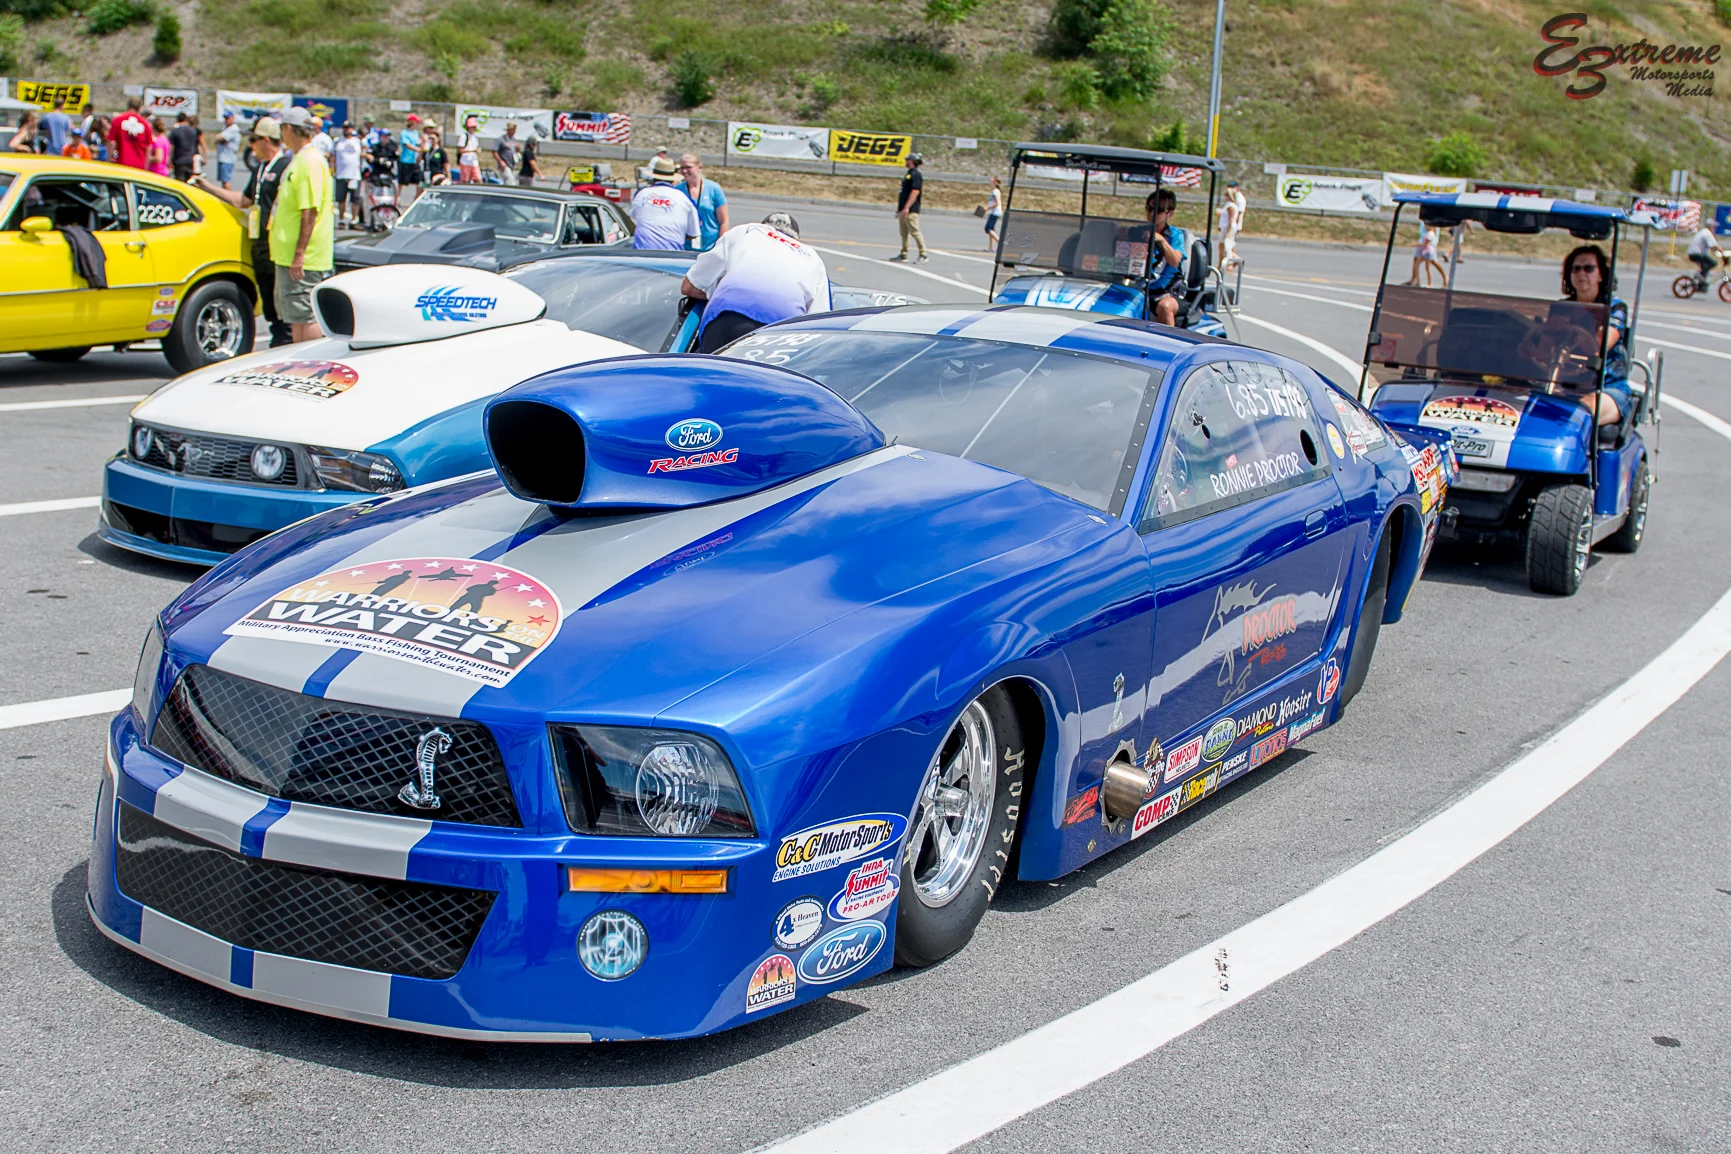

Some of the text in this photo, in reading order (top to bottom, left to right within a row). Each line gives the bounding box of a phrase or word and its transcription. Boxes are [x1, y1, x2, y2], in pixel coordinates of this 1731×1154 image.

[24, 86, 84, 105] JEGS
[153, 95, 184, 106] XRP
[737, 127, 762, 148] E3
[837, 135, 906, 157] JEGS
[1286, 178, 1312, 199] E3
[414, 295, 497, 310] SPEEDTECH
[221, 376, 336, 399] WATER
[1225, 384, 1268, 419] 6.85
[678, 424, 712, 446] Ford
[647, 448, 739, 474] RACING
[1209, 451, 1304, 498] RONNIE PROCTOR
[289, 588, 507, 633] WARRIORS
[268, 602, 521, 665] WATER
[502, 631, 537, 645] THE
[509, 623, 547, 638] ON
[1242, 600, 1297, 656] PROCTOR
[238, 620, 511, 677] Military Appreciation Bass Fishing Tournament
[324, 637, 500, 684] www.warriorsonthewater.com
[1275, 688, 1312, 727] Hoosier
[1237, 703, 1277, 738] DIAMOND
[1287, 705, 1328, 744] MagnaFuel
[1168, 741, 1201, 772] SIMPSON
[1221, 750, 1248, 774] PENSKE
[1134, 795, 1172, 832] COMP
[1157, 808, 1175, 823] CAMS
[777, 832, 821, 868] C&C
[818, 820, 894, 857] MotorSports
[773, 857, 841, 881] ENGINE SOLUTIONS
[861, 859, 883, 874] IHRA
[846, 867, 889, 899] SUMMIT
[842, 898, 875, 914] PRO-AM
[876, 890, 896, 903] TOUR
[797, 911, 819, 922] Heaven
[816, 931, 870, 975] Ford
[748, 984, 793, 1005] WATER
[749, 978, 788, 995] WARRIORS
